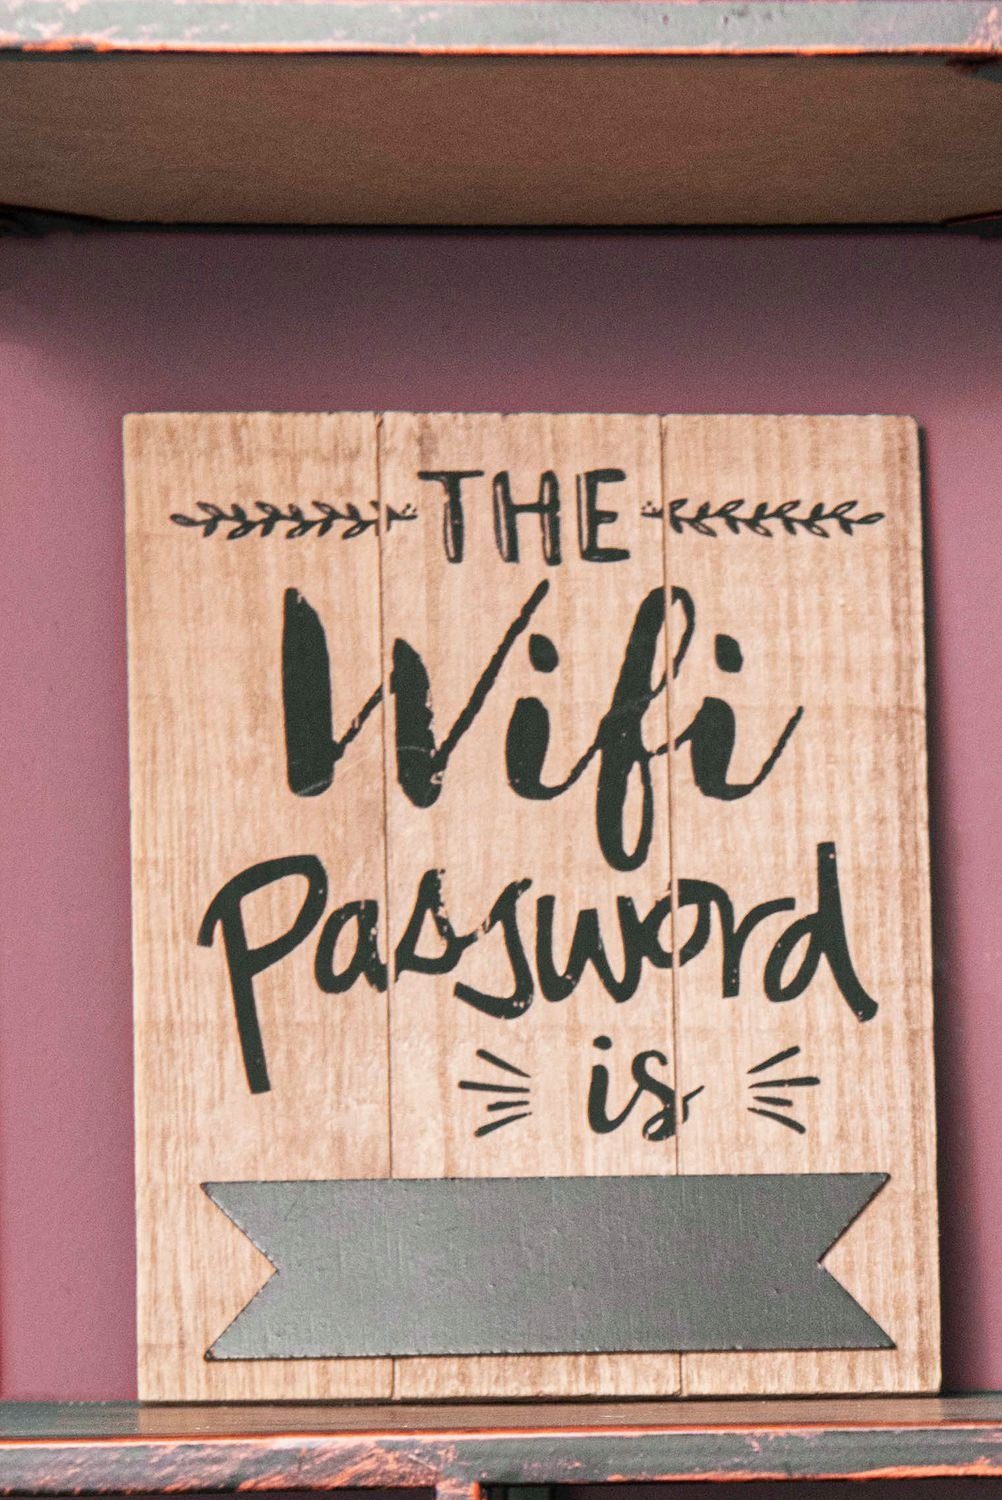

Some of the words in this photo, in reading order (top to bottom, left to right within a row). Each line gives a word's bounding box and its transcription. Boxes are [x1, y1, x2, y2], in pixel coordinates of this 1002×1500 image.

[417, 468, 632, 567] THE
[281, 578, 804, 872] Wifi
[197, 841, 879, 1094] Password
[587, 1034, 705, 1143] is
